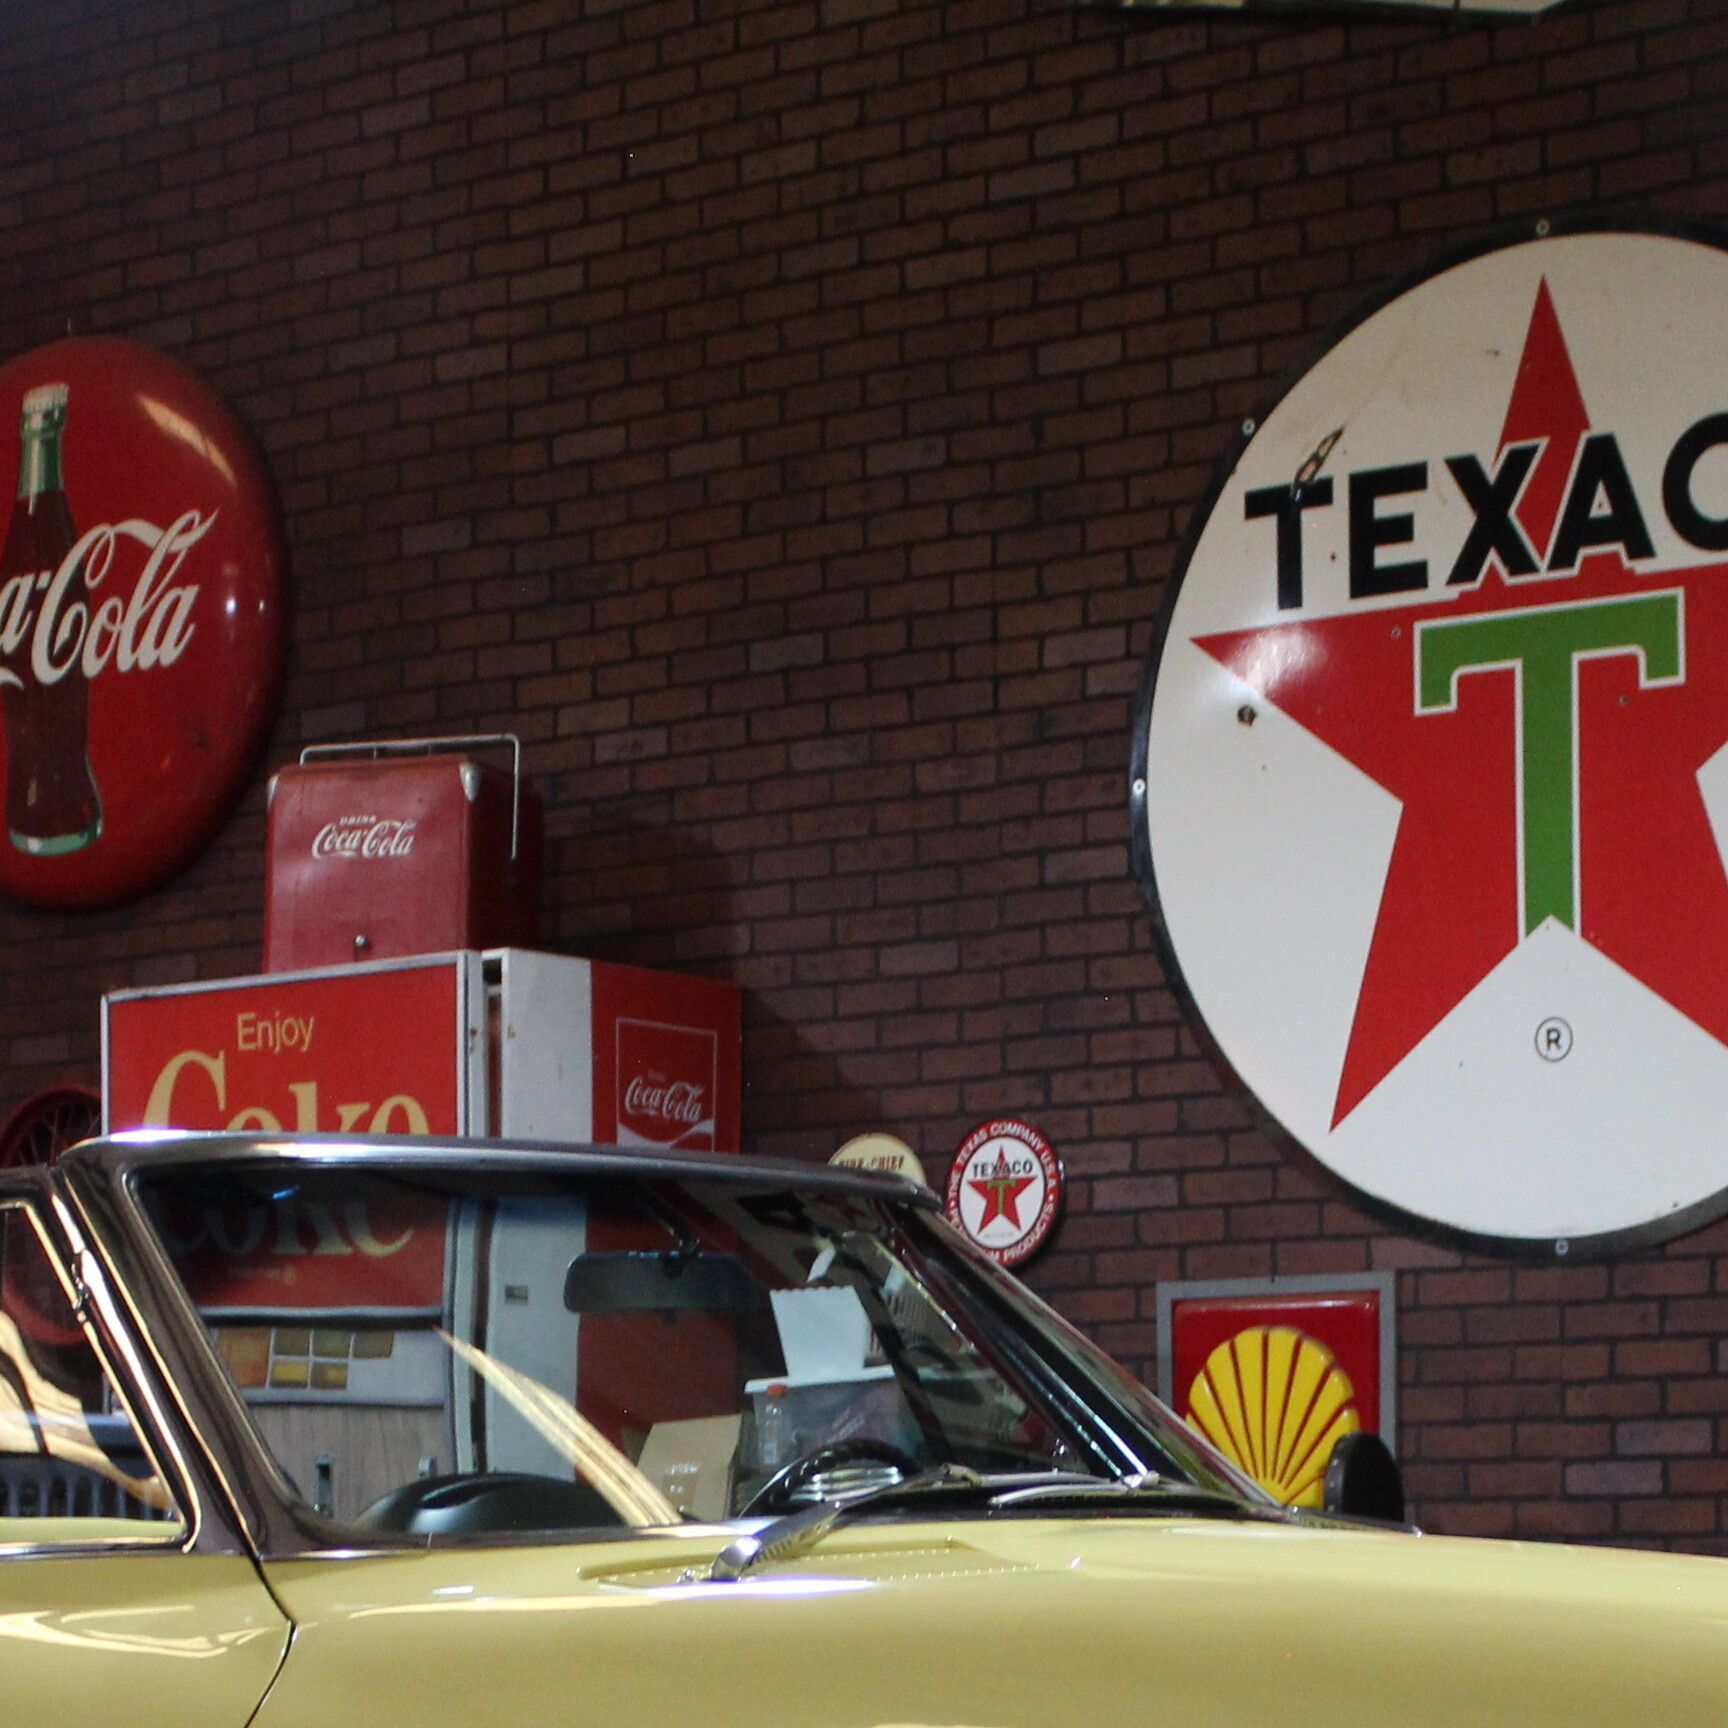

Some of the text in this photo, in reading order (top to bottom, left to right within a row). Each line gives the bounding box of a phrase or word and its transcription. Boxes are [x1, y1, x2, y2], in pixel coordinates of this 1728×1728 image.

[311, 818, 418, 859] Coca-Cola
[236, 1011, 315, 1053] Enjoy
[624, 1076, 705, 1121] Coca-Cola
[957, 1128, 988, 1165] TEXAS
[989, 1120, 1046, 1152] COMPANY
[972, 1159, 1034, 1178] TEXACO
[1002, 1201, 1056, 1262] PRODUCTS
